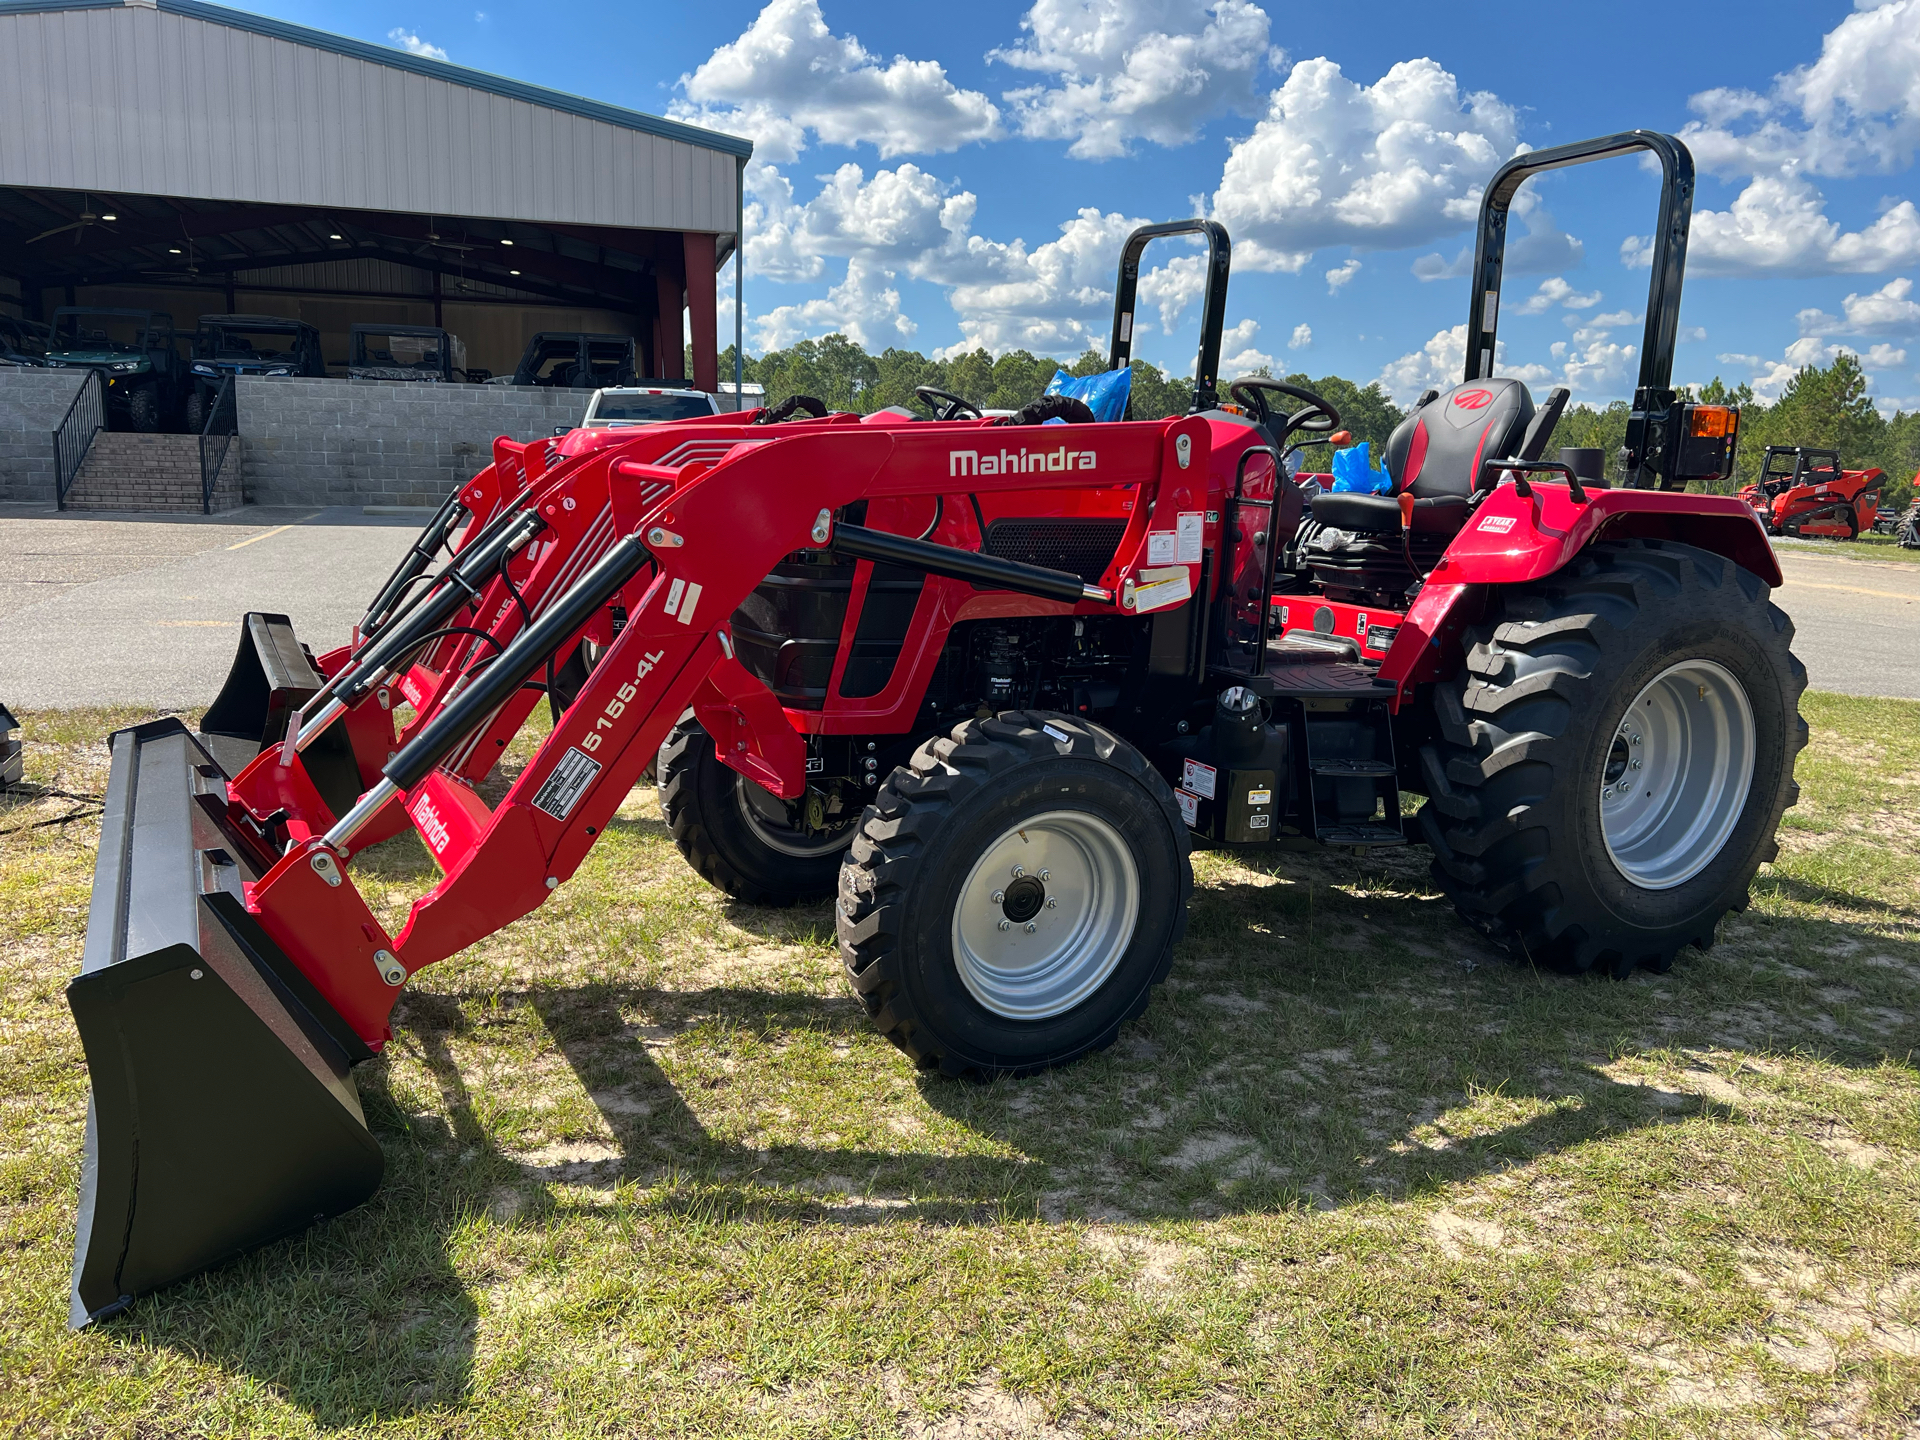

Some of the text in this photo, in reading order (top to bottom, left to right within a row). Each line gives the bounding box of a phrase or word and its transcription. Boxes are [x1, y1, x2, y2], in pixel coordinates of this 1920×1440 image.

[949, 446, 1097, 477] Mahindra
[581, 650, 665, 752] 5155-4L
[412, 792, 451, 855] Mahindra
